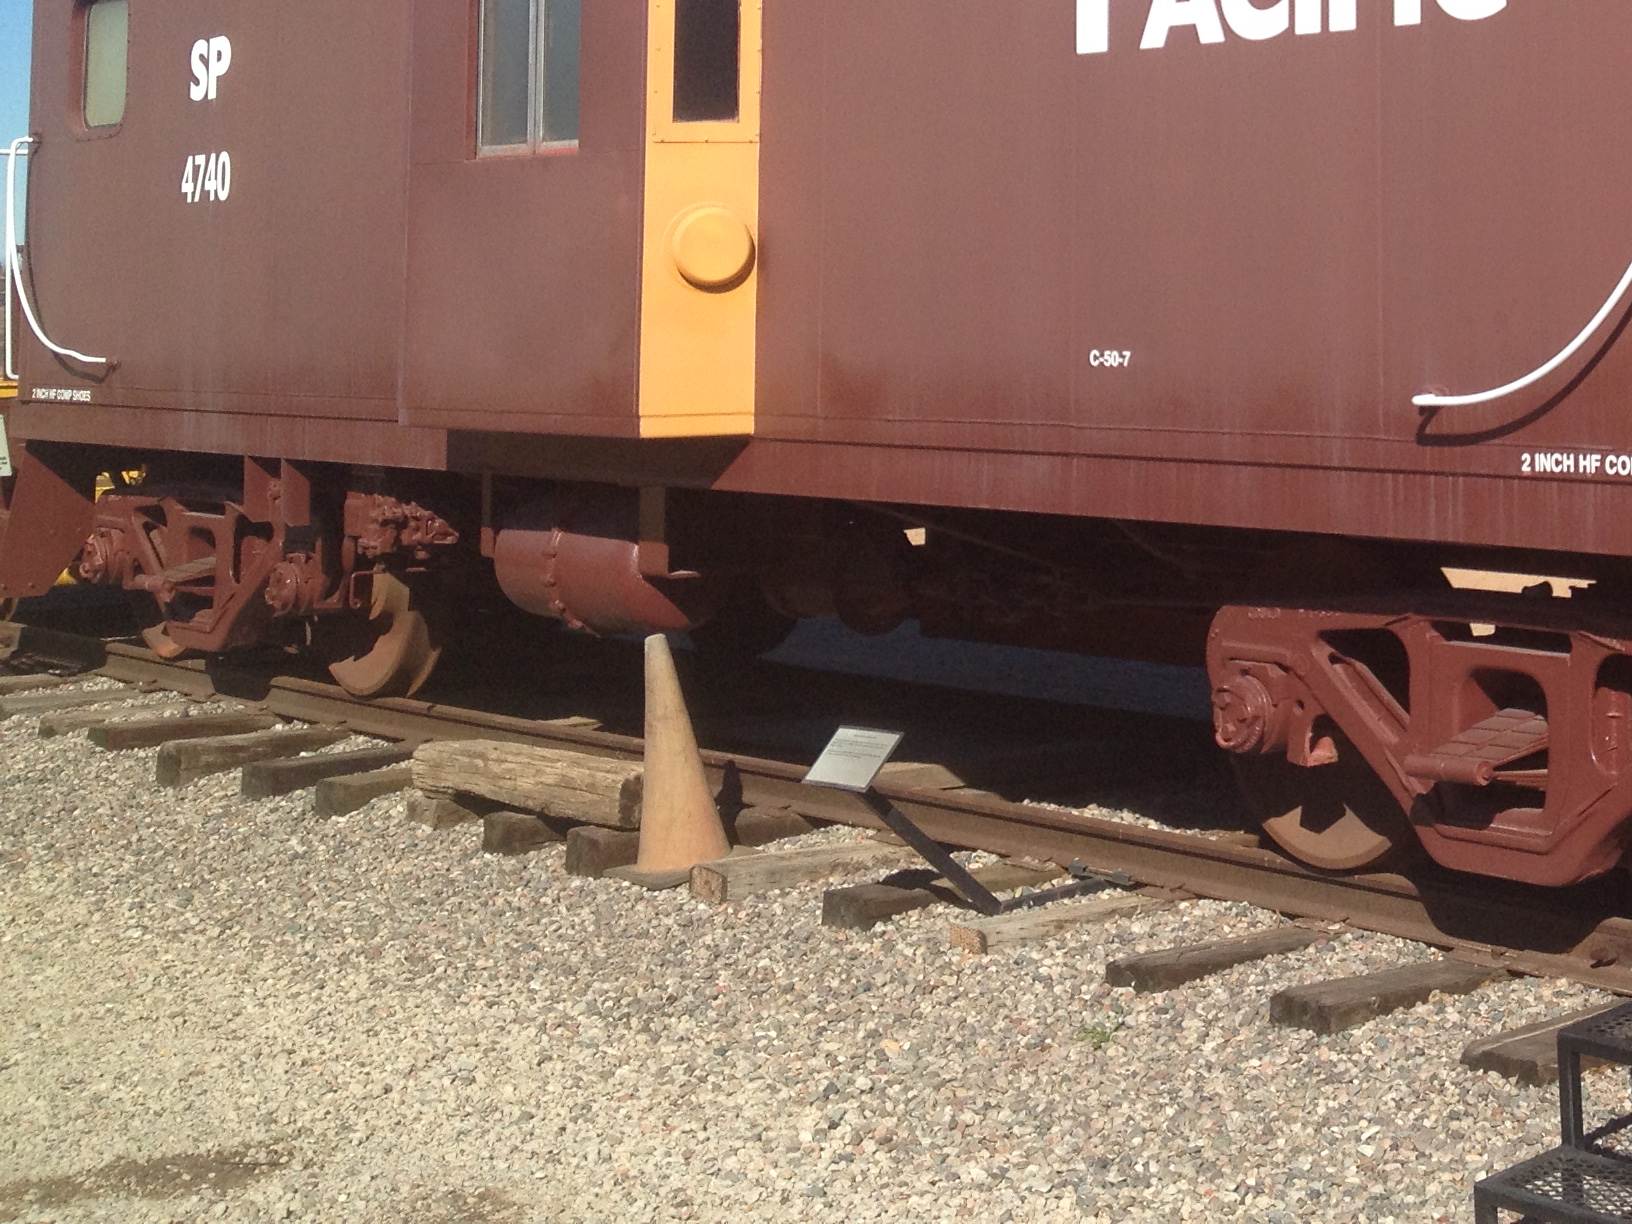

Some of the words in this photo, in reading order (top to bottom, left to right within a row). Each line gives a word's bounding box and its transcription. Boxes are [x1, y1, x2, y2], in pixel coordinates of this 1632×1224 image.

[190, 35, 231, 101] SP
[181, 150, 231, 203] 4740
[1089, 349, 1131, 367] C-50-7
[1521, 452, 1531, 472] 2
[1534, 453, 1575, 473] INCH
[1578, 454, 1602, 474] HF
